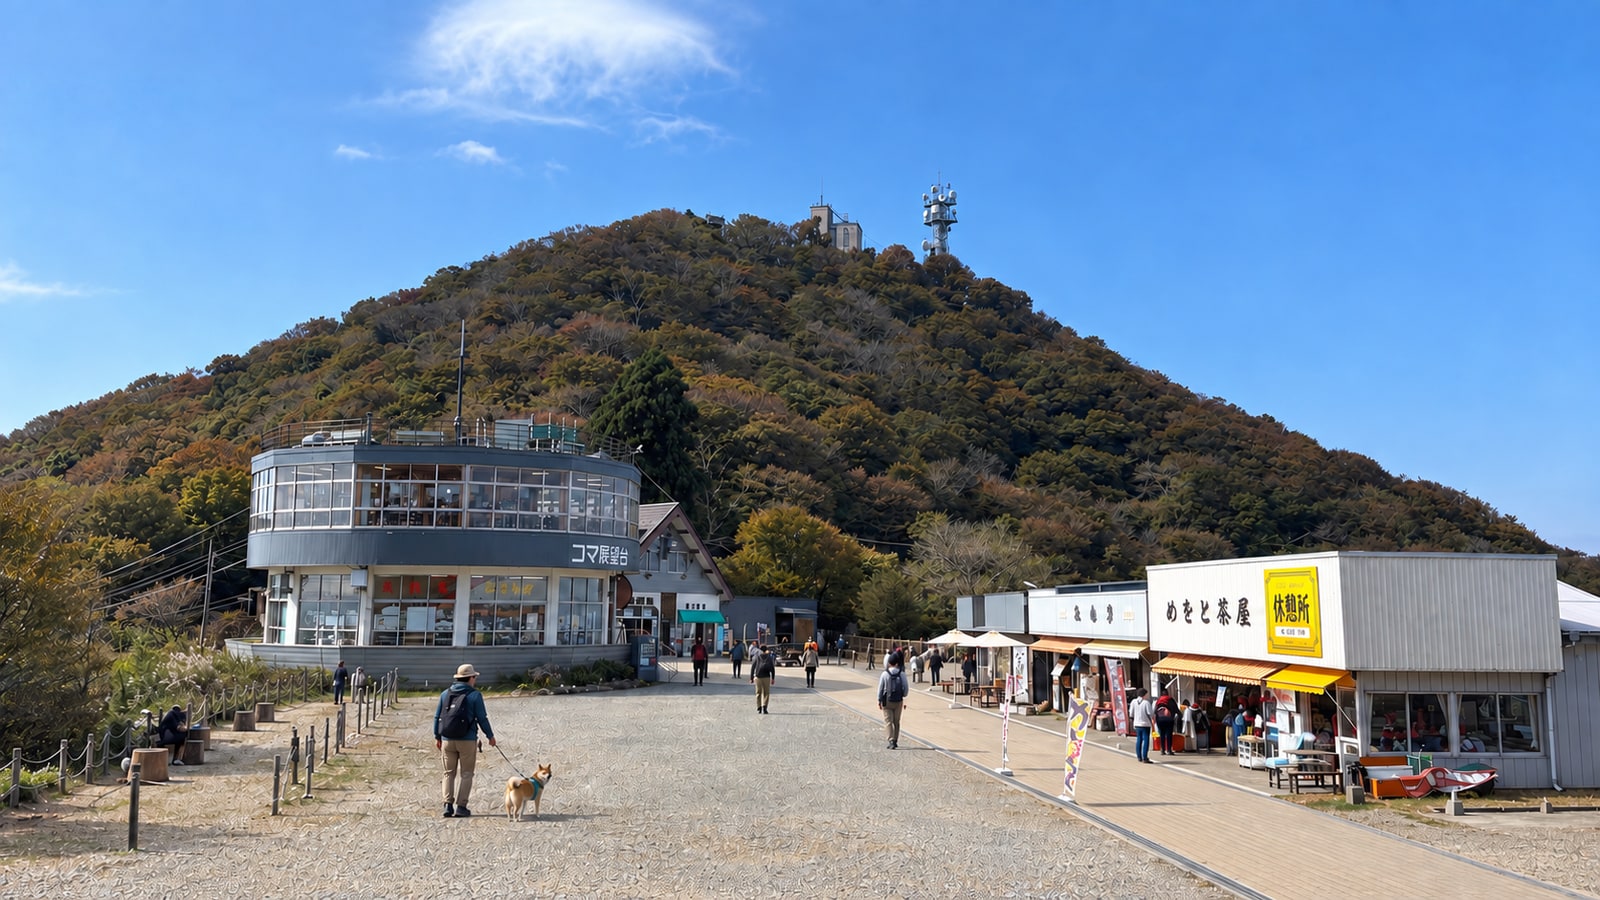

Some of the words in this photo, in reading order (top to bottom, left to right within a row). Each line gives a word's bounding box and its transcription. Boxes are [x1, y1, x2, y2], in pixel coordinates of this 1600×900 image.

[572, 544, 628, 566] コマ展望台
[1166, 597, 1251, 627] めをと茶屋
[1273, 593, 1310, 624] 休憩所
